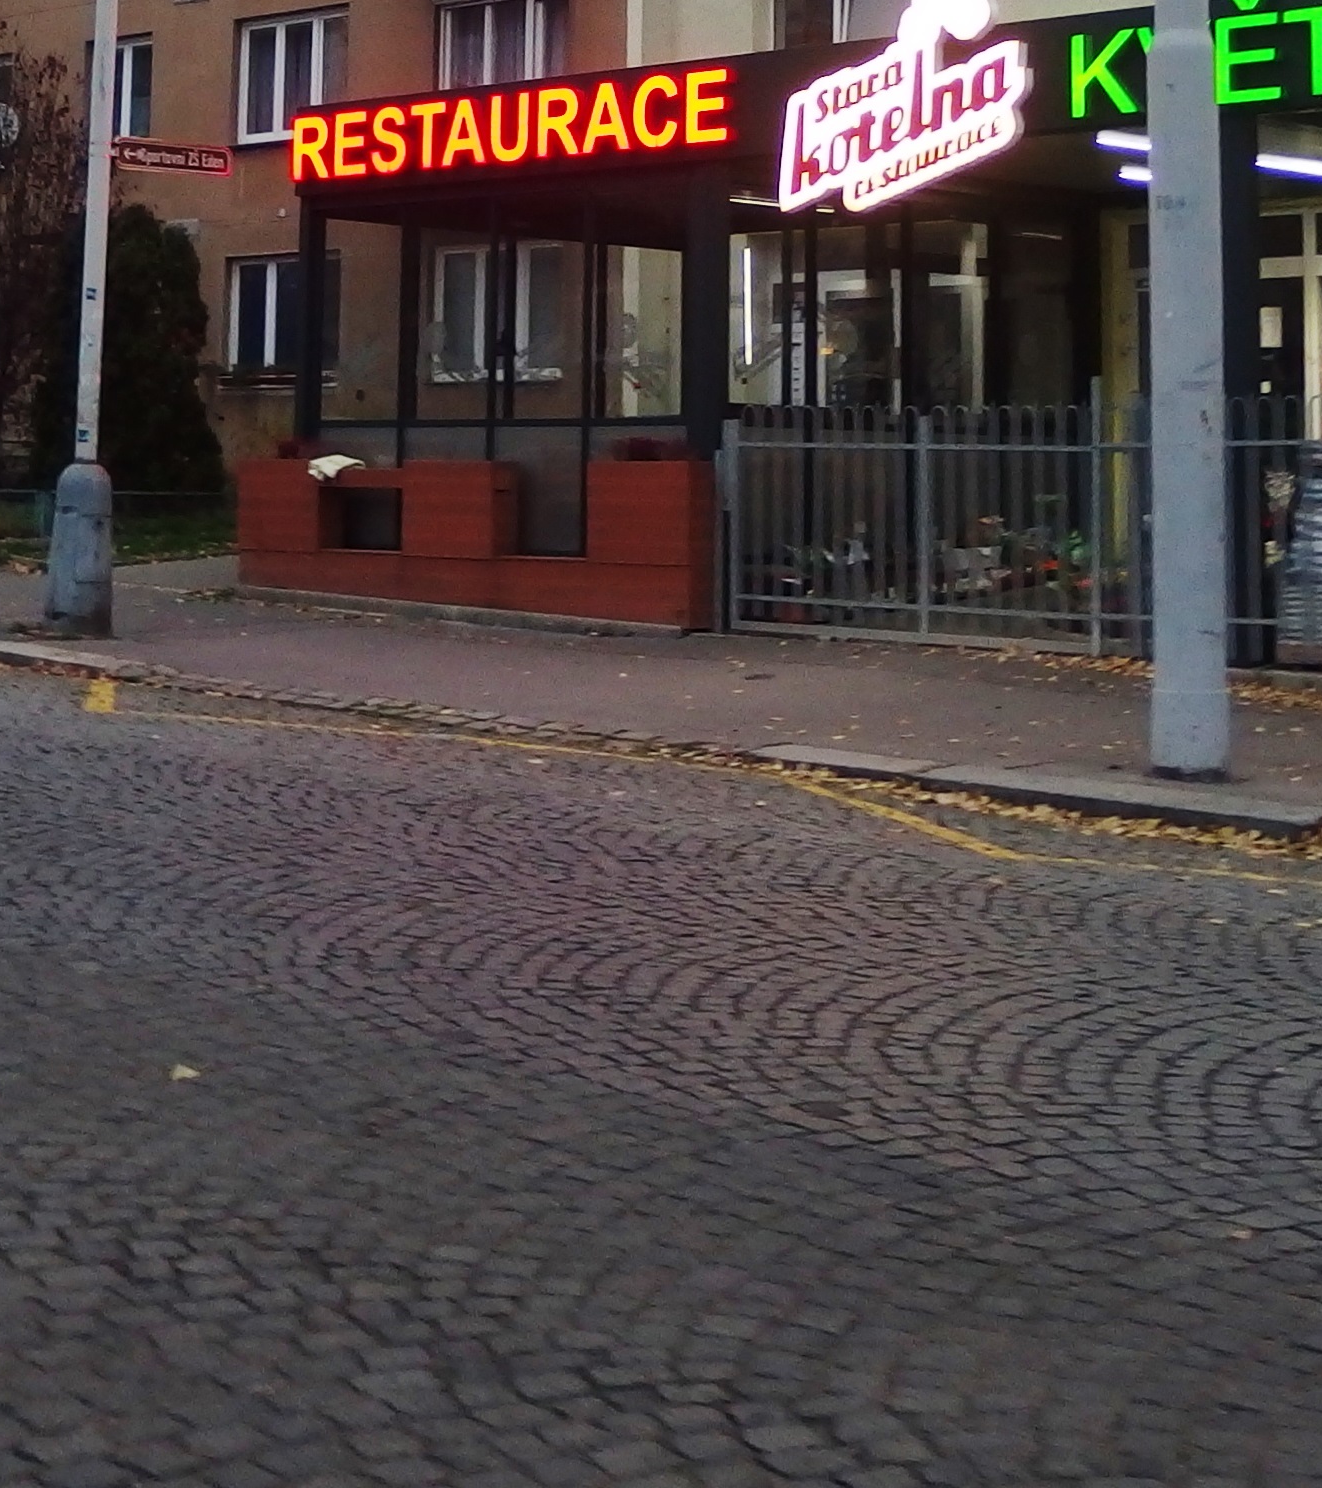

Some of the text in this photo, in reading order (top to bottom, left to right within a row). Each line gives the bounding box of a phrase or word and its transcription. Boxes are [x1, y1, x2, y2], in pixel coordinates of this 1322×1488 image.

[290, 68, 729, 182] RESTAURACE
[790, 49, 1013, 196] kotelna
[854, 115, 1003, 200] restaurace
